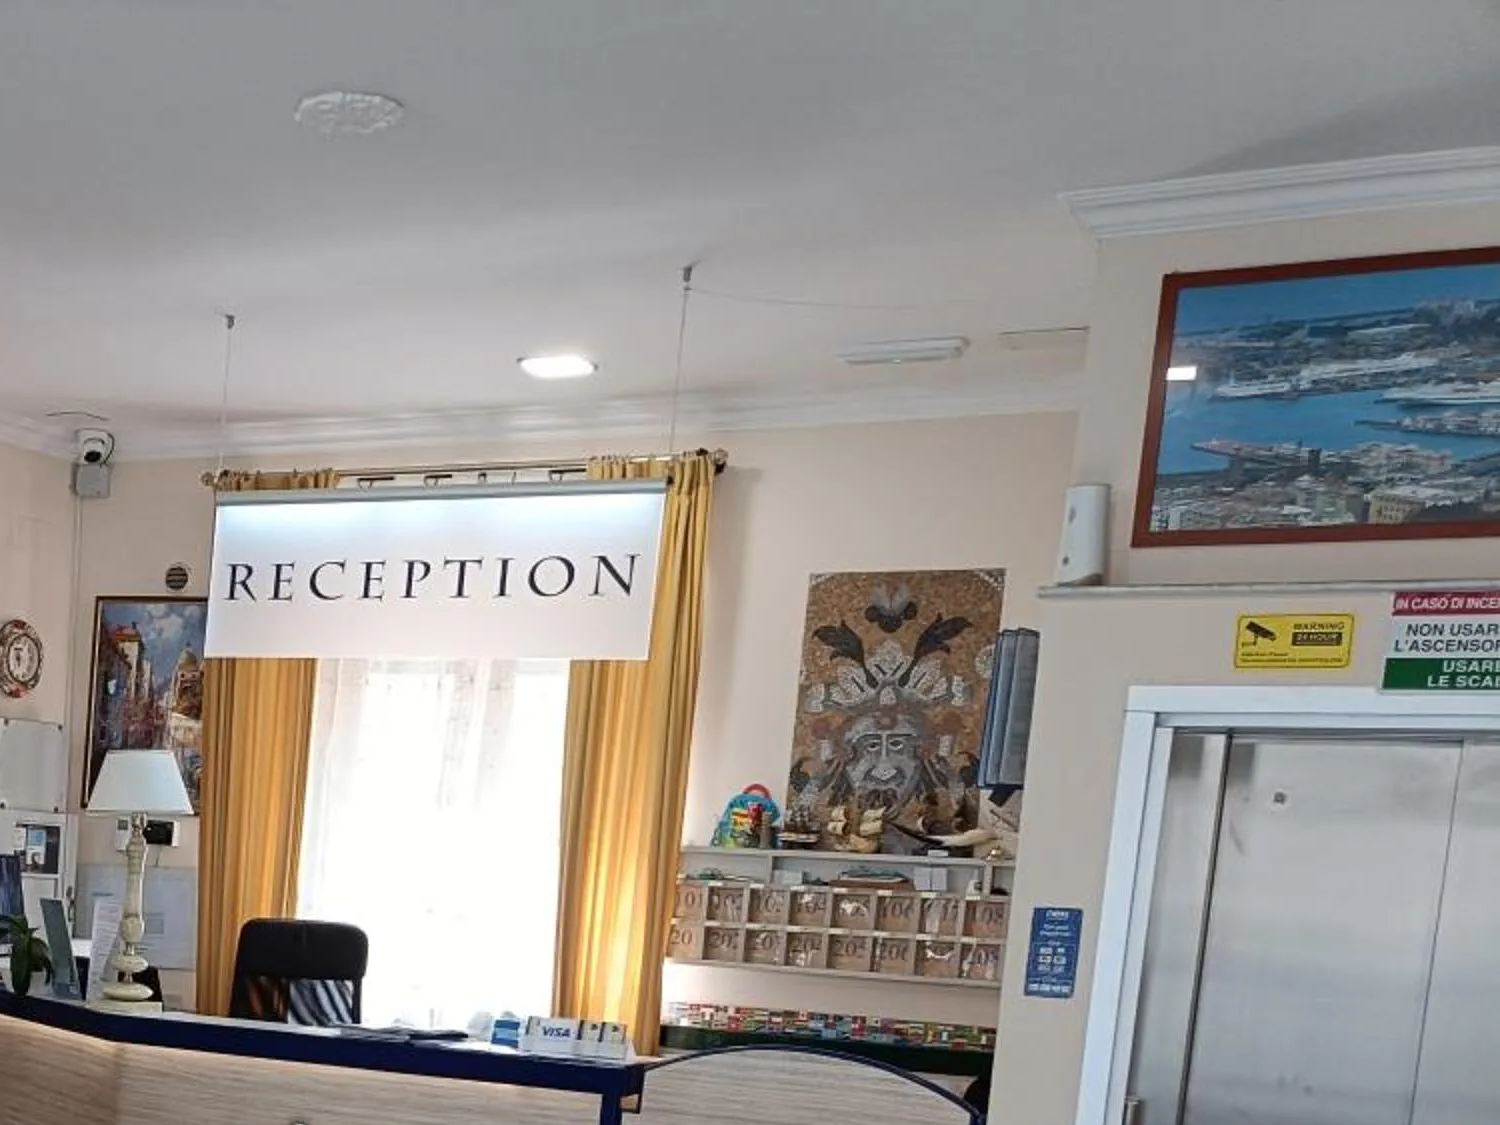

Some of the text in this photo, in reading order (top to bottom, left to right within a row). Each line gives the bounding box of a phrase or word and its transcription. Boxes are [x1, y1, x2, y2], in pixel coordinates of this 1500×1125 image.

[227, 553, 641, 602] RECEPTION
[1411, 597, 1449, 609] CASO
[1406, 623, 1445, 637] NON
[1427, 675, 1450, 688] LE
[542, 1025, 571, 1038] VISA
